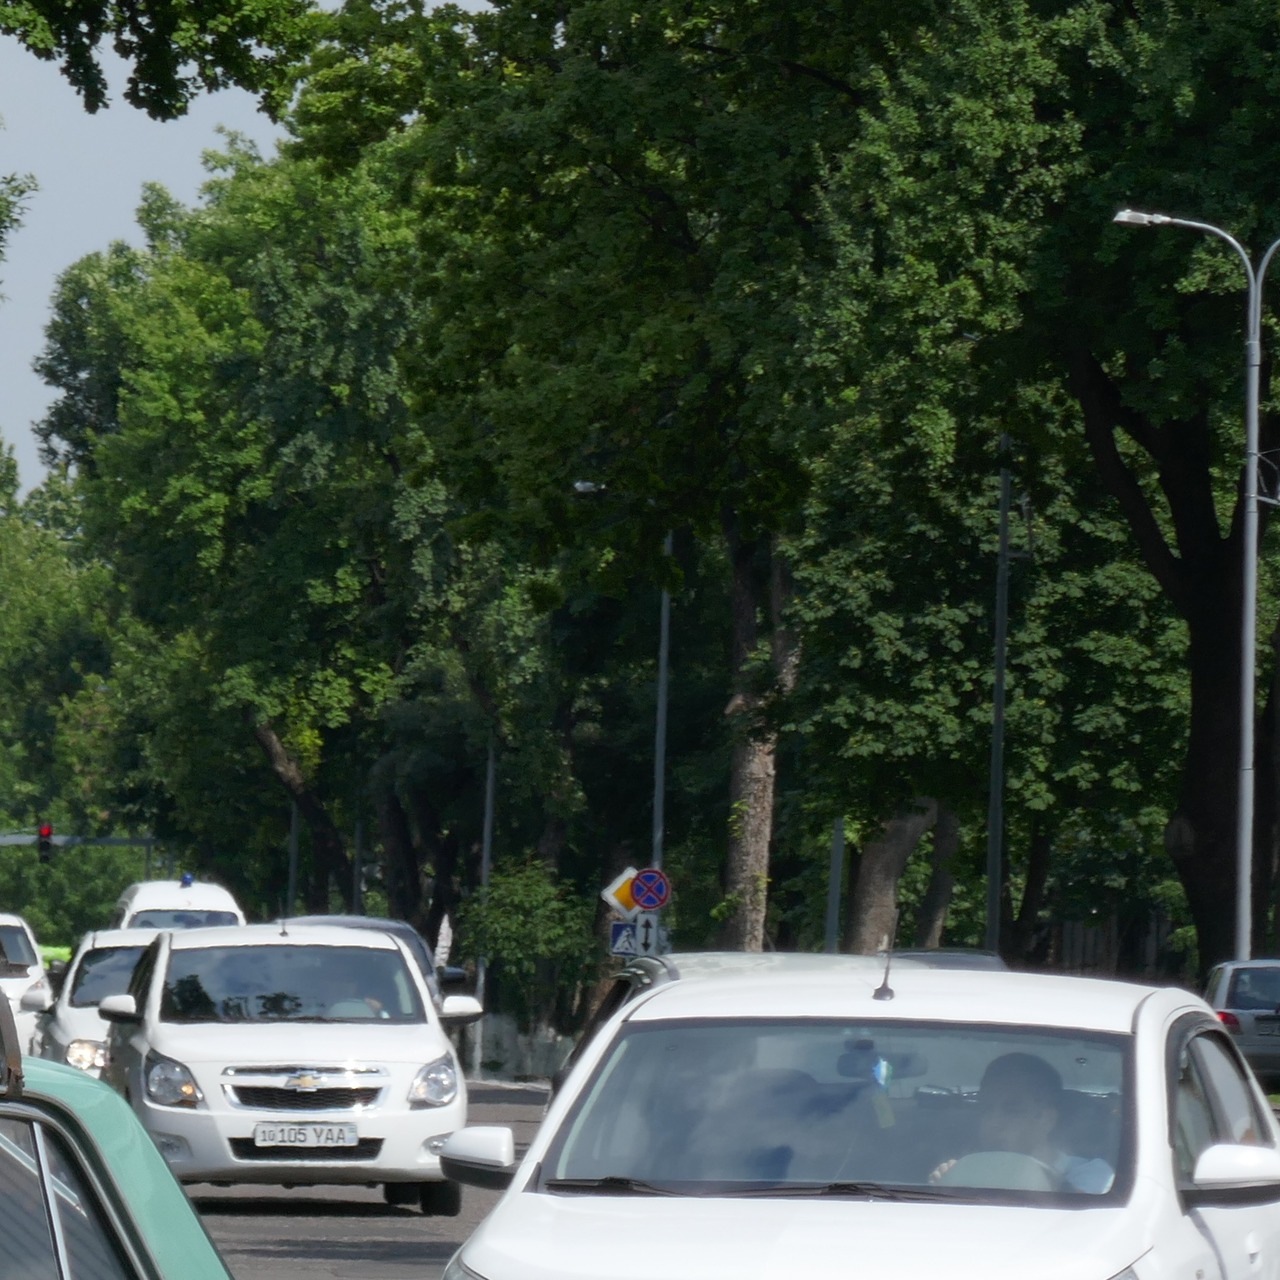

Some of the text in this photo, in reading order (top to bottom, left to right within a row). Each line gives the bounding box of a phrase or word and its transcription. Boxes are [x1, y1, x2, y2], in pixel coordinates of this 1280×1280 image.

[261, 1127, 346, 1144] 10 105 YAA
